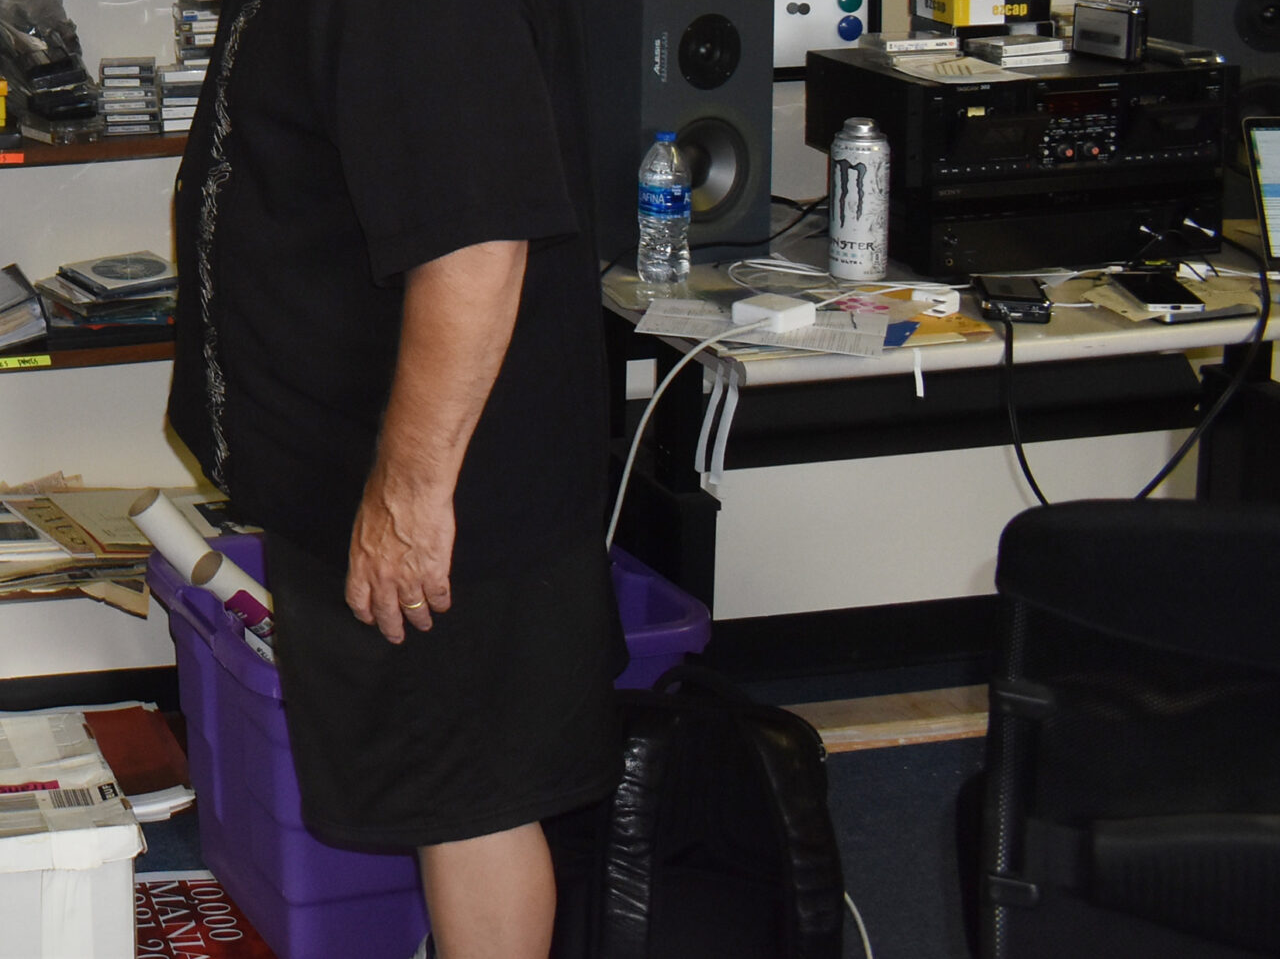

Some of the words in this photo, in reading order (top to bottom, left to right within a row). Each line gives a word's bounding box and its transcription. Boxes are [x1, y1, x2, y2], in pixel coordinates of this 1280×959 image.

[992, 2, 1028, 17] ezcap
[832, 238, 875, 252] NSTER
[186, 878, 243, 942] 10,000
